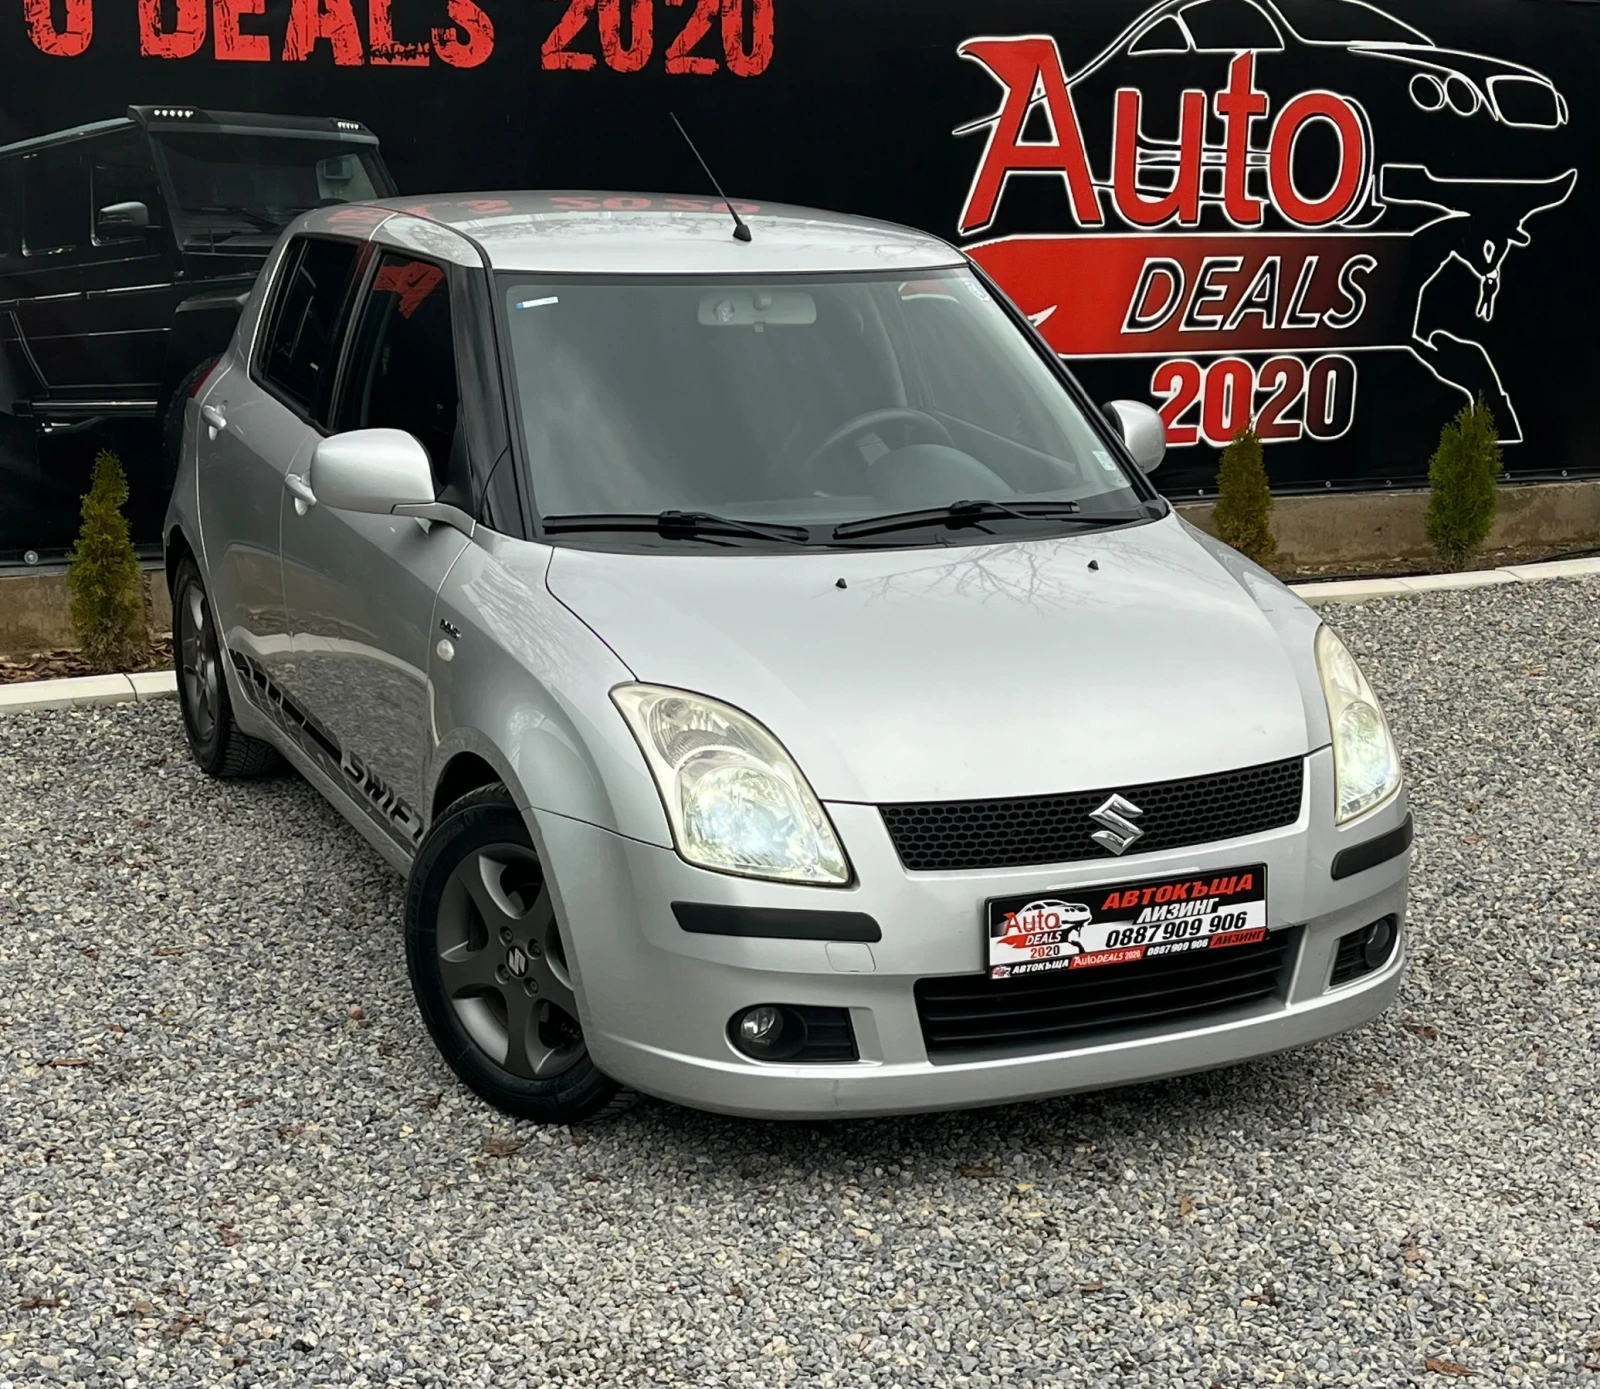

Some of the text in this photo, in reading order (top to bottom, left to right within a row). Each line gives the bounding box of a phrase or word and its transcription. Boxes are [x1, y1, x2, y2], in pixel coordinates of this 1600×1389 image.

[541, 0, 774, 77] 2020
[957, 35, 1365, 235] Auto
[1120, 254, 1378, 334] DEALS
[1151, 354, 1357, 447] 2020
[1101, 874, 1253, 910] АВТОКЪЩА
[1003, 908, 1061, 935] Auto
[1136, 898, 1220, 924] ЛИЗИНГ
[1208, 911, 1248, 933] 906
[1025, 931, 1063, 946] DEALS
[1191, 938, 1209, 950] 906
[1213, 930, 1266, 945] ЛИЗИНГ
[1030, 945, 1060, 959] 2020
[1012, 959, 1069, 974] АВТОКЪЩА
